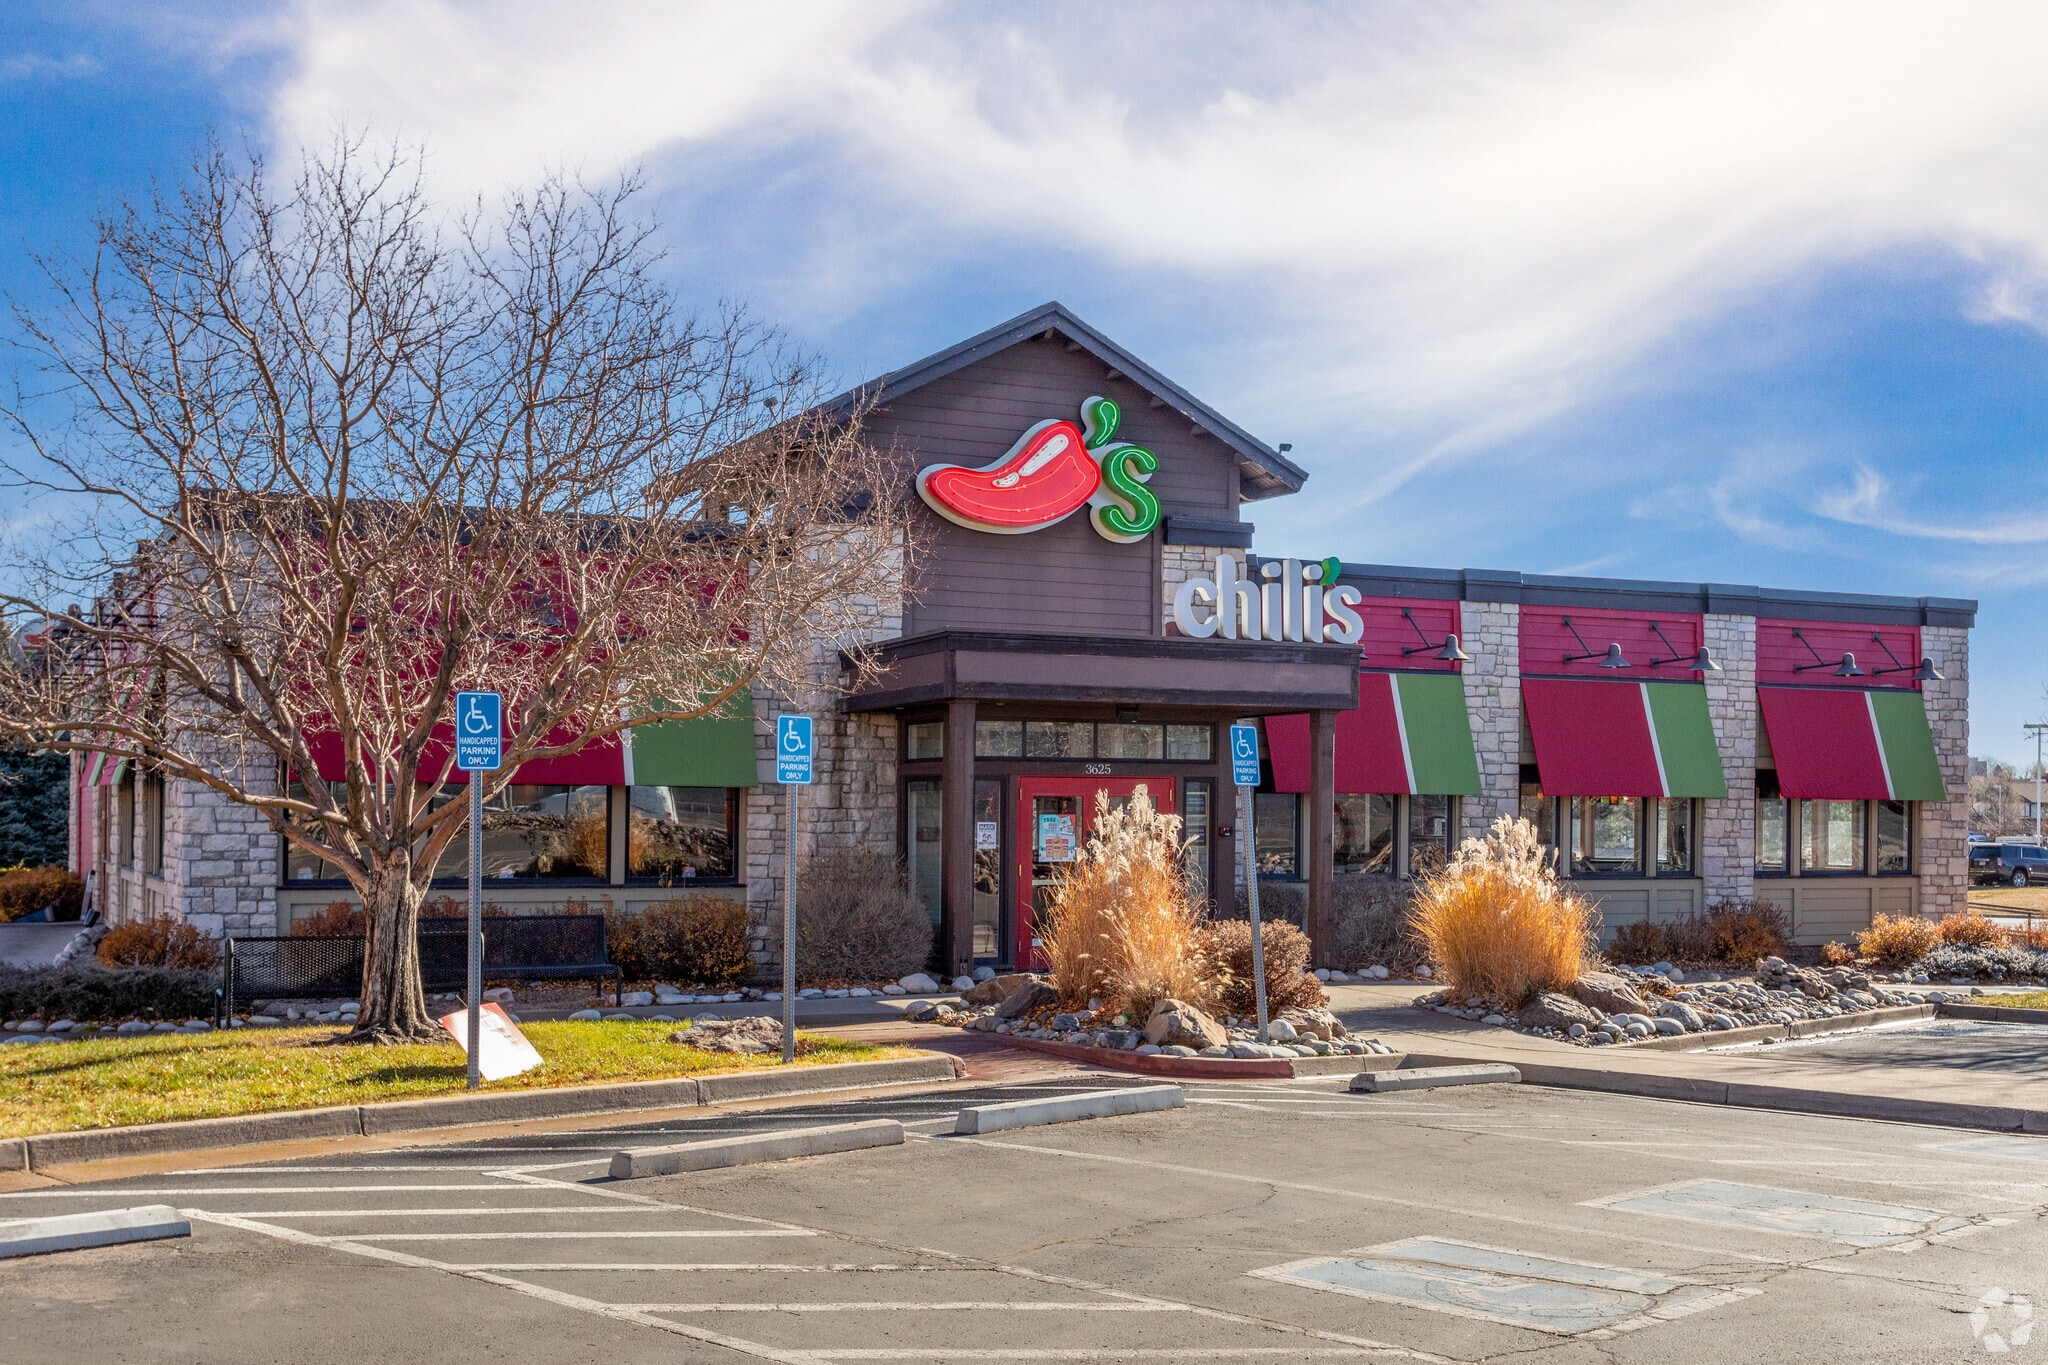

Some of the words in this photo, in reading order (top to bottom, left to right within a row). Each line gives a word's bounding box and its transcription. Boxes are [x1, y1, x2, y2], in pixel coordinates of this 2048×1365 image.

[1174, 554, 1364, 644] chili's
[459, 736, 498, 745] HANDICAPPED
[461, 746, 496, 755] PARKING
[468, 756, 489, 765] ONLY
[779, 754, 810, 763] HANDICAPPED
[780, 763, 808, 771] PARKING
[1085, 763, 1112, 775] 3625
[1235, 767, 1257, 775] PARKING
[785, 772, 803, 780] ONLY
